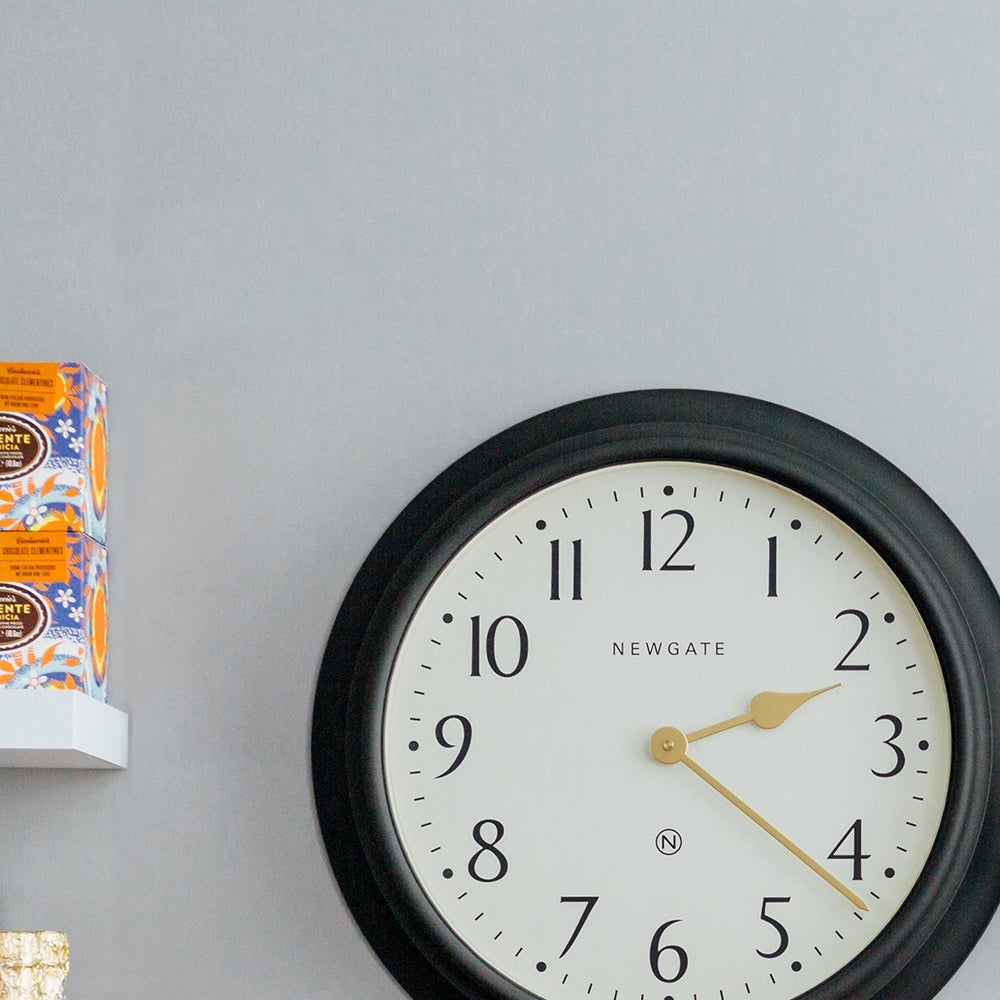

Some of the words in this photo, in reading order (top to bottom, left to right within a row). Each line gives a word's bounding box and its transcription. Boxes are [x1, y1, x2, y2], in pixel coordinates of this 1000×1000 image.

[550, 539, 582, 600] 11
[642, 509, 695, 571] 12
[768, 536, 777, 597] 1
[470, 615, 528, 677] 10
[613, 642, 724, 655] NEWGATE
[834, 609, 870, 671] 2
[435, 715, 472, 779] 9
[871, 715, 905, 777] 3
[468, 819, 508, 882] 8
[827, 819, 871, 880] 4
[559, 897, 599, 959] 7
[650, 920, 688, 983] 6
[756, 897, 791, 958] 5
